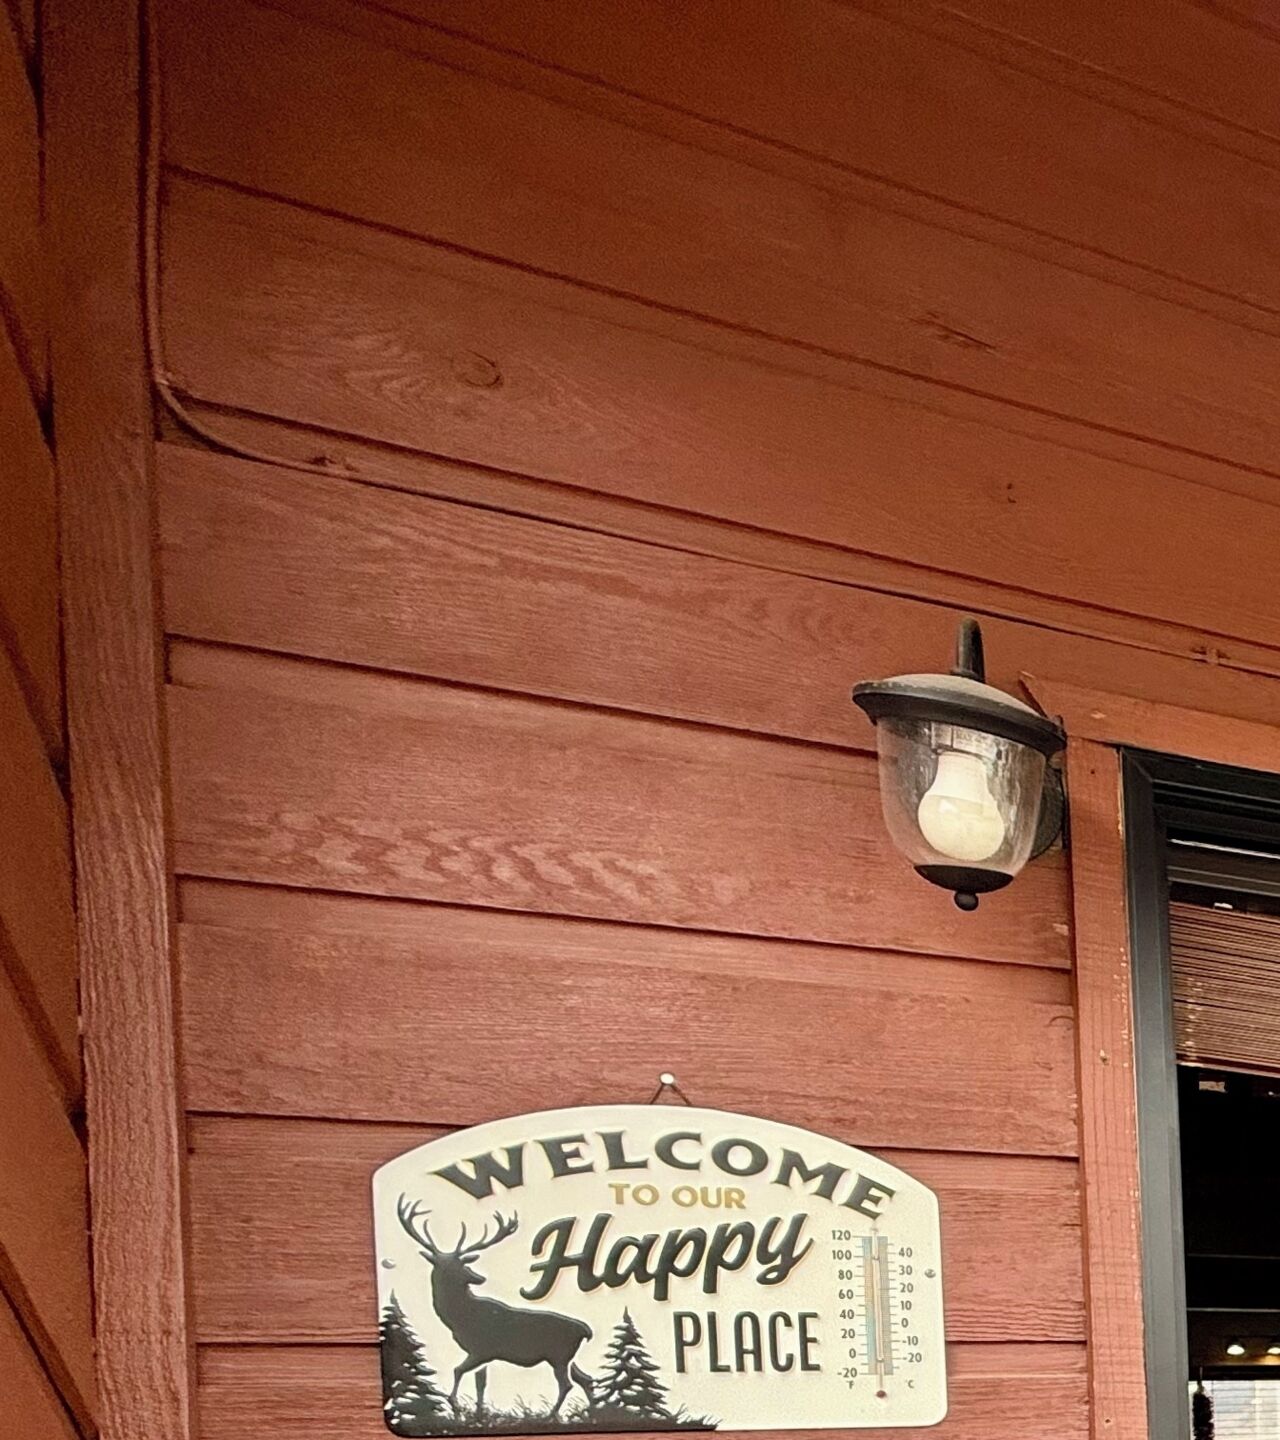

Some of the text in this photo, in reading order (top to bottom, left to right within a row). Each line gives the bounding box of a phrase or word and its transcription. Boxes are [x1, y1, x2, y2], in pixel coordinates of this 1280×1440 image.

[427, 1130, 896, 1221] WELCOME
[608, 1183, 747, 1210] TO OUR
[831, 1230, 852, 1241] 120
[519, 1213, 815, 1302] Happy
[832, 1250, 852, 1260] 100
[898, 1247, 913, 1258] 40
[838, 1270, 853, 1280] 80
[899, 1265, 913, 1276] 30
[900, 1283, 914, 1293] 20
[838, 1289, 854, 1300] 60
[901, 1300, 912, 1310] 10
[839, 1309, 855, 1320] 40
[901, 1318, 909, 1328] 0
[841, 1329, 856, 1339] 20
[673, 1311, 822, 1373] PLACE
[849, 1348, 857, 1358] 0
[903, 1353, 922, 1363] -20
[837, 1367, 858, 1378] -20
